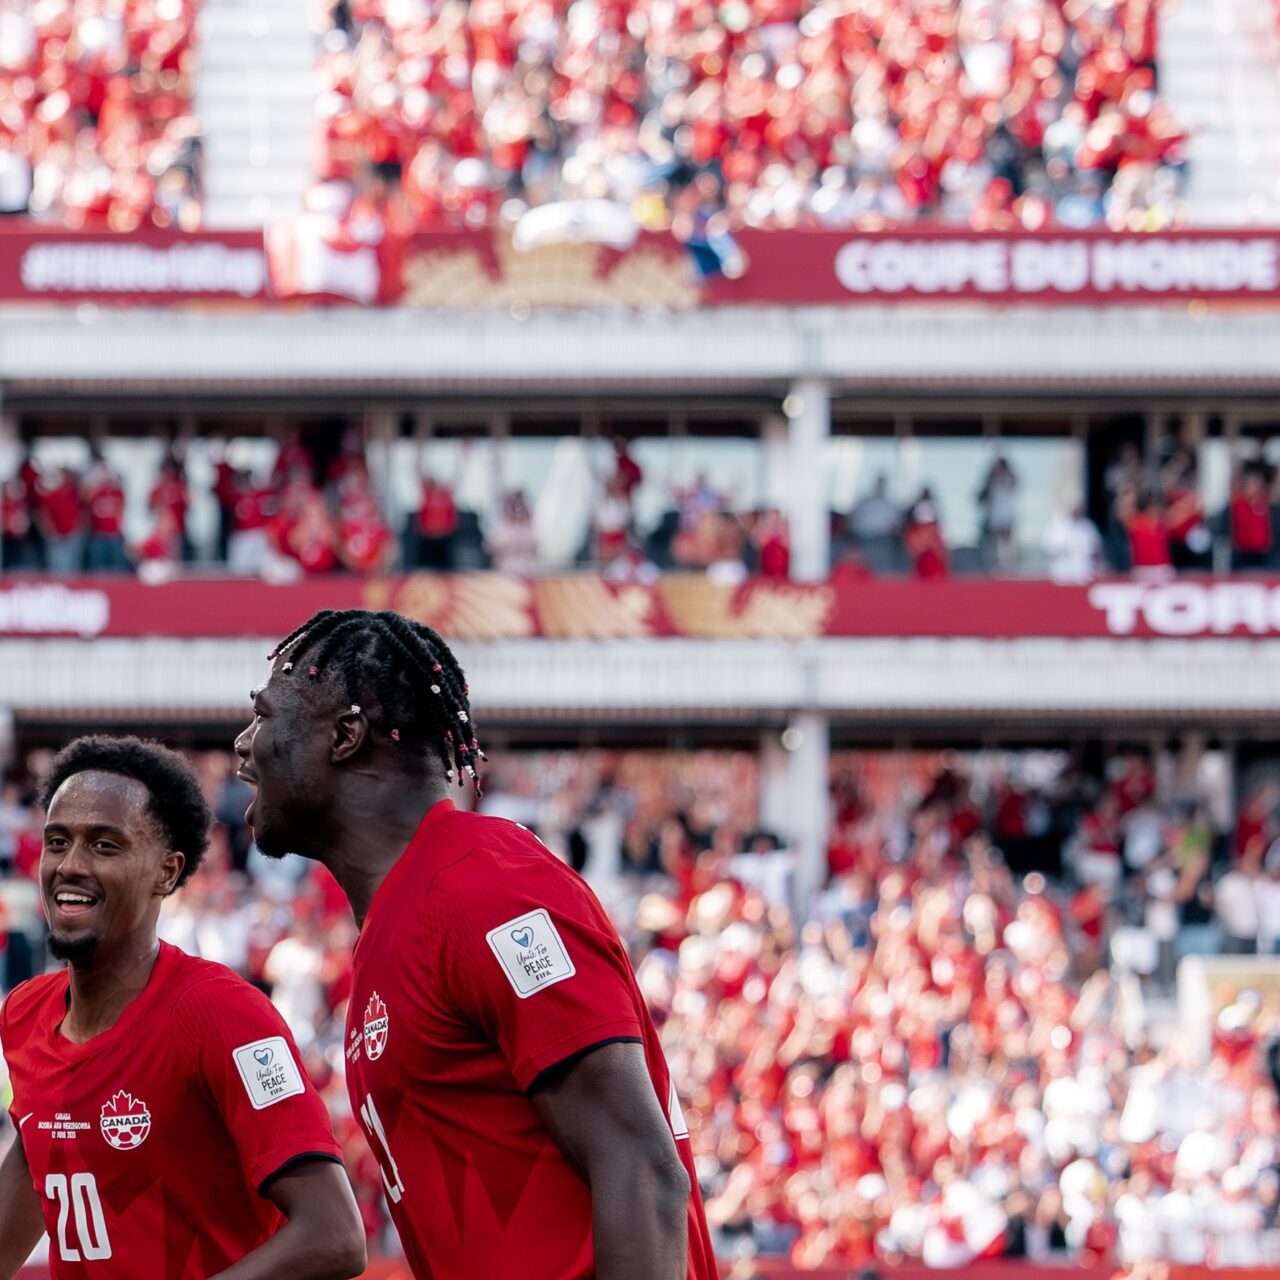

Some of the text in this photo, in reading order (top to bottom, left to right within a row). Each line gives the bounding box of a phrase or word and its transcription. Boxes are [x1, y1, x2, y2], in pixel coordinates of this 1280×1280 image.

[834, 238, 1280, 292] COUPE DU MONDE
[516, 943, 547, 966] Unite For
[523, 955, 554, 977] PEACE
[535, 970, 552, 981] FIFA
[365, 1019, 387, 1036] CANADA
[256, 1068, 273, 1081] Unite
[261, 1073, 287, 1091] PEACE
[270, 1087, 284, 1096] FIFA
[101, 1116, 149, 1128] CANADA
[45, 1172, 112, 1262] 20
